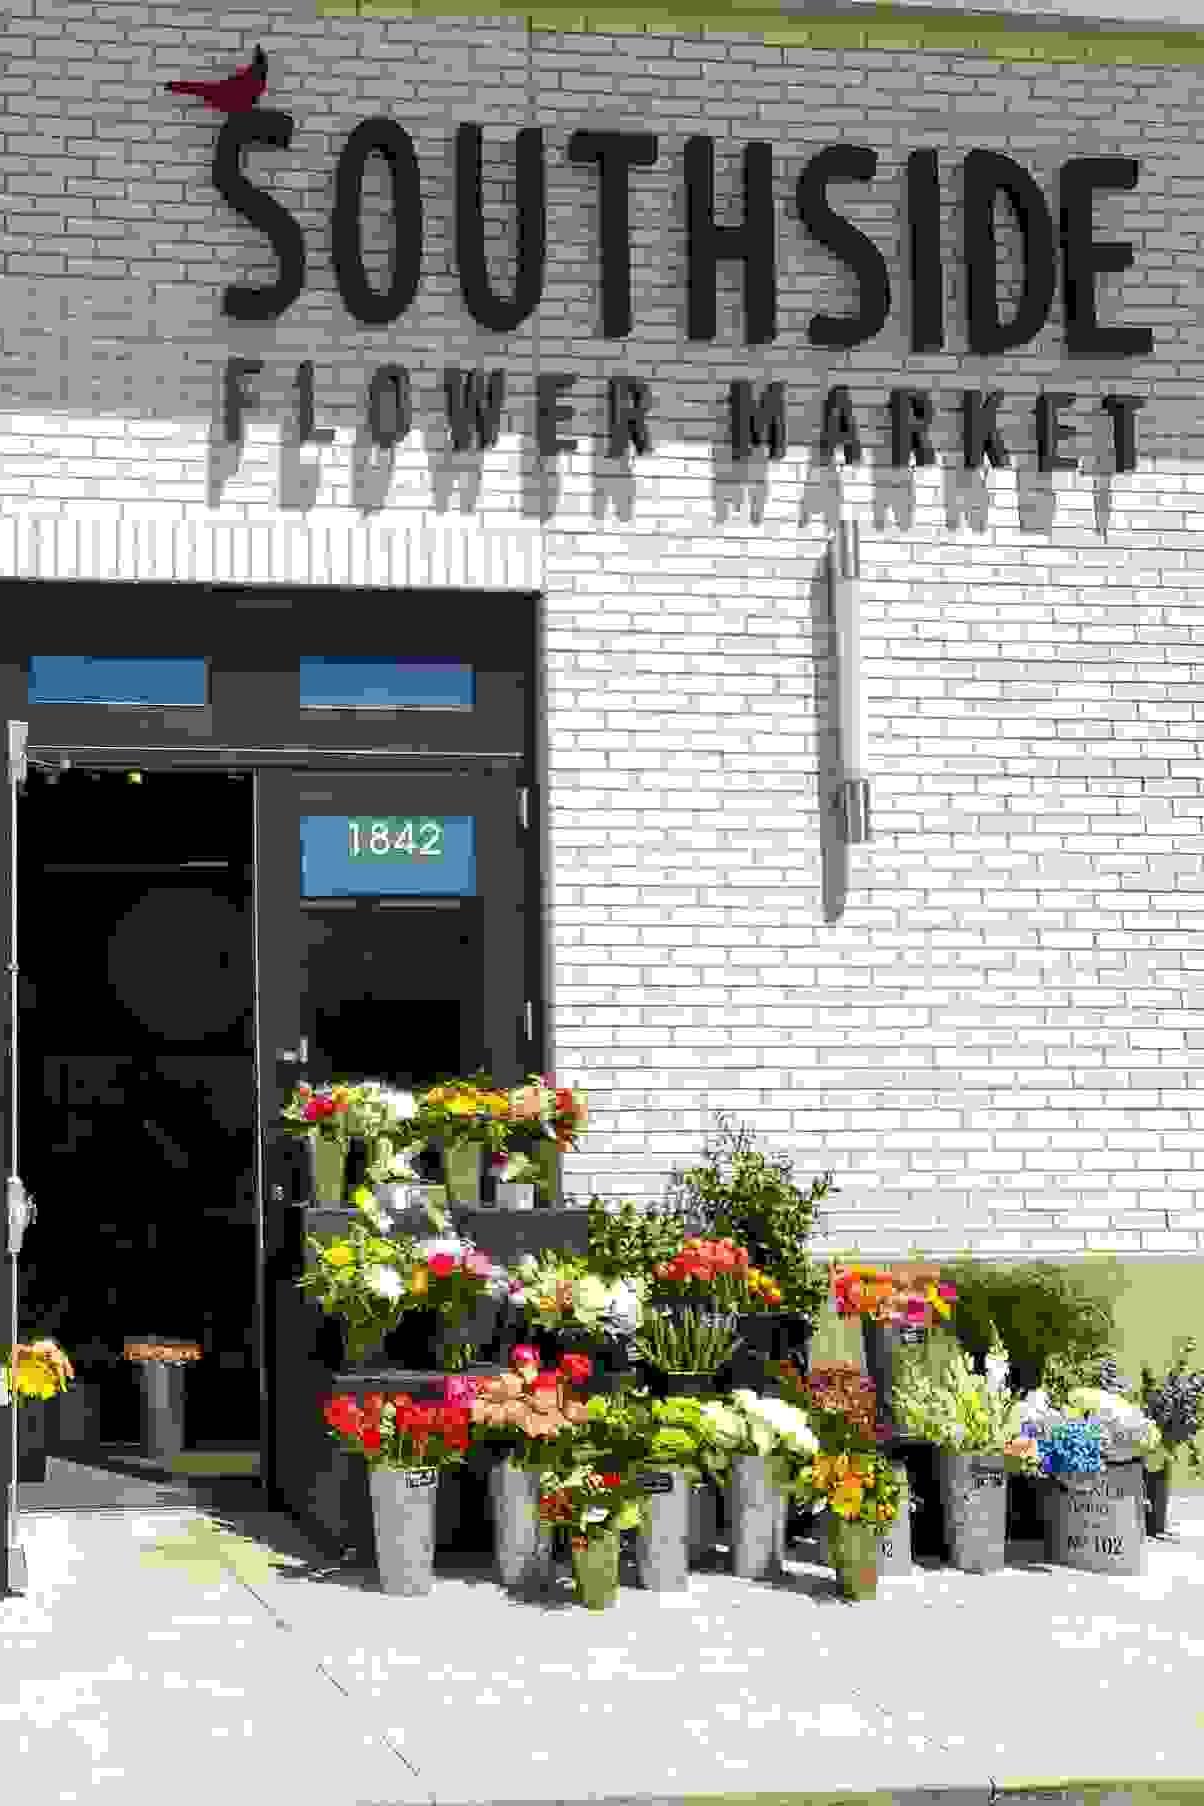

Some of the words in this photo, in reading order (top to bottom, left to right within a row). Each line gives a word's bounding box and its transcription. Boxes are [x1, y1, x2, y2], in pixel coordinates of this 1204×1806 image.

[211, 110, 1154, 358] SOUTHSIDE
[222, 358, 649, 458] FLOWER
[724, 380, 1149, 474] MARKET
[348, 821, 443, 856] 1842
